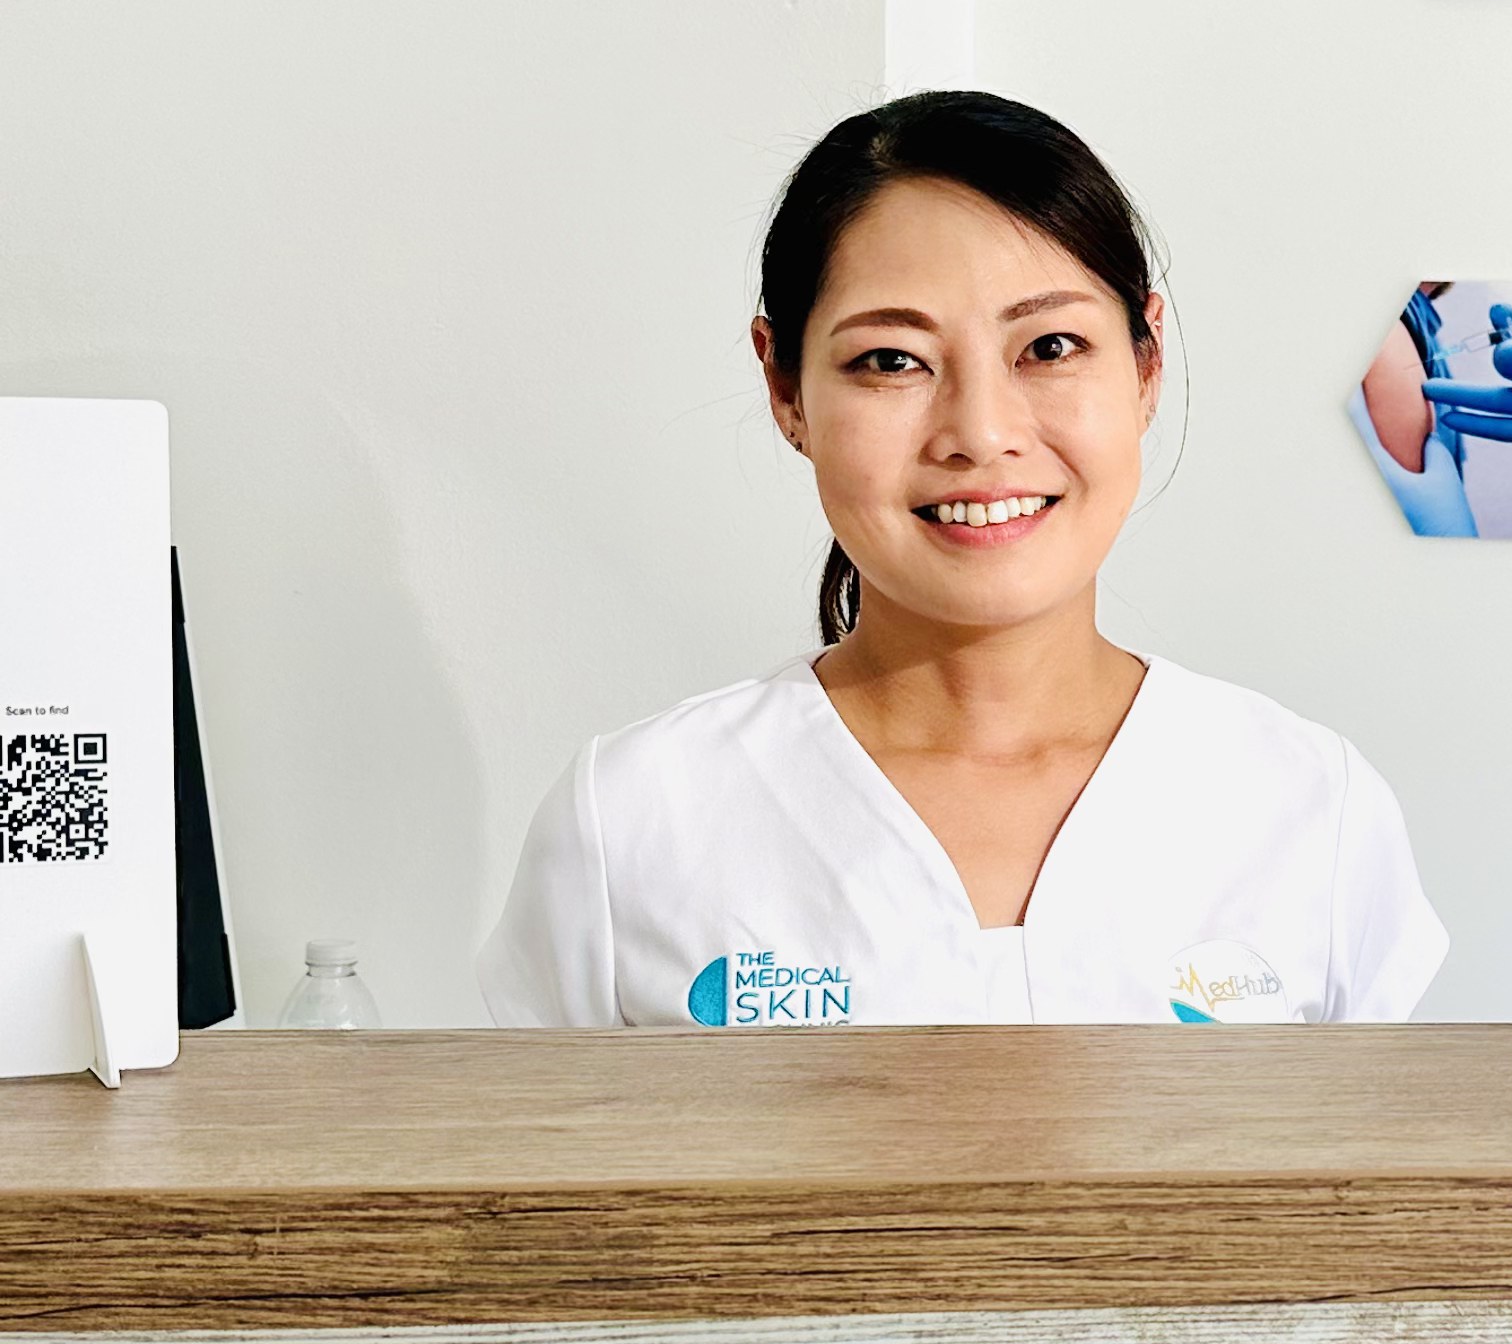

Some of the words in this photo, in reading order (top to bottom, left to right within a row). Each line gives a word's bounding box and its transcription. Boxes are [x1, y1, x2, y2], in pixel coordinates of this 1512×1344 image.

[6, 706, 32, 716] Scan
[35, 706, 46, 716] to
[49, 705, 69, 715] find
[736, 951, 775, 966] THE
[736, 965, 851, 989] MEDICAL
[736, 985, 850, 1023] SKIN
